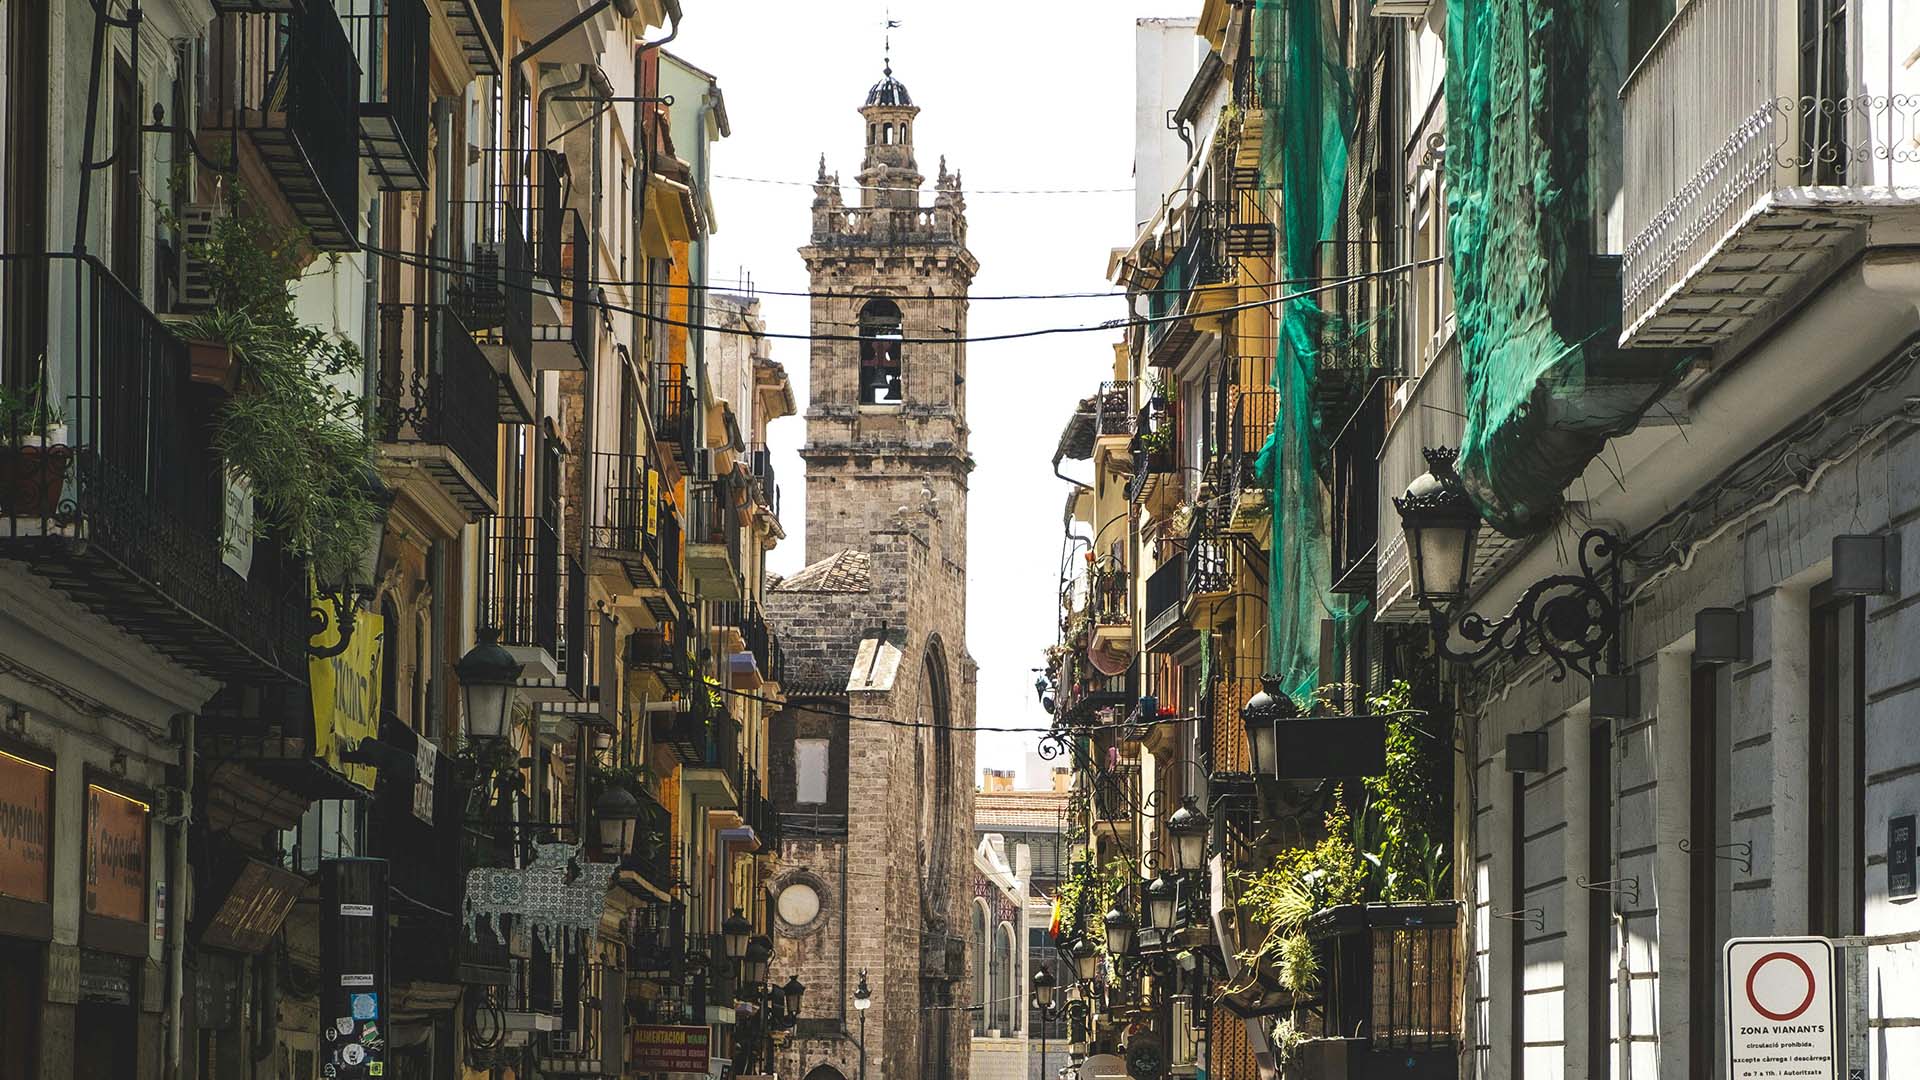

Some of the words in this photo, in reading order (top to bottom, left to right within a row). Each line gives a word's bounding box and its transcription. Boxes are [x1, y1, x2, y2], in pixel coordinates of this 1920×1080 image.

[1740, 1027, 1769, 1035] ZONA
[1772, 1025, 1825, 1034] VIANANTS
[1762, 1056, 1788, 1064] càrrega
